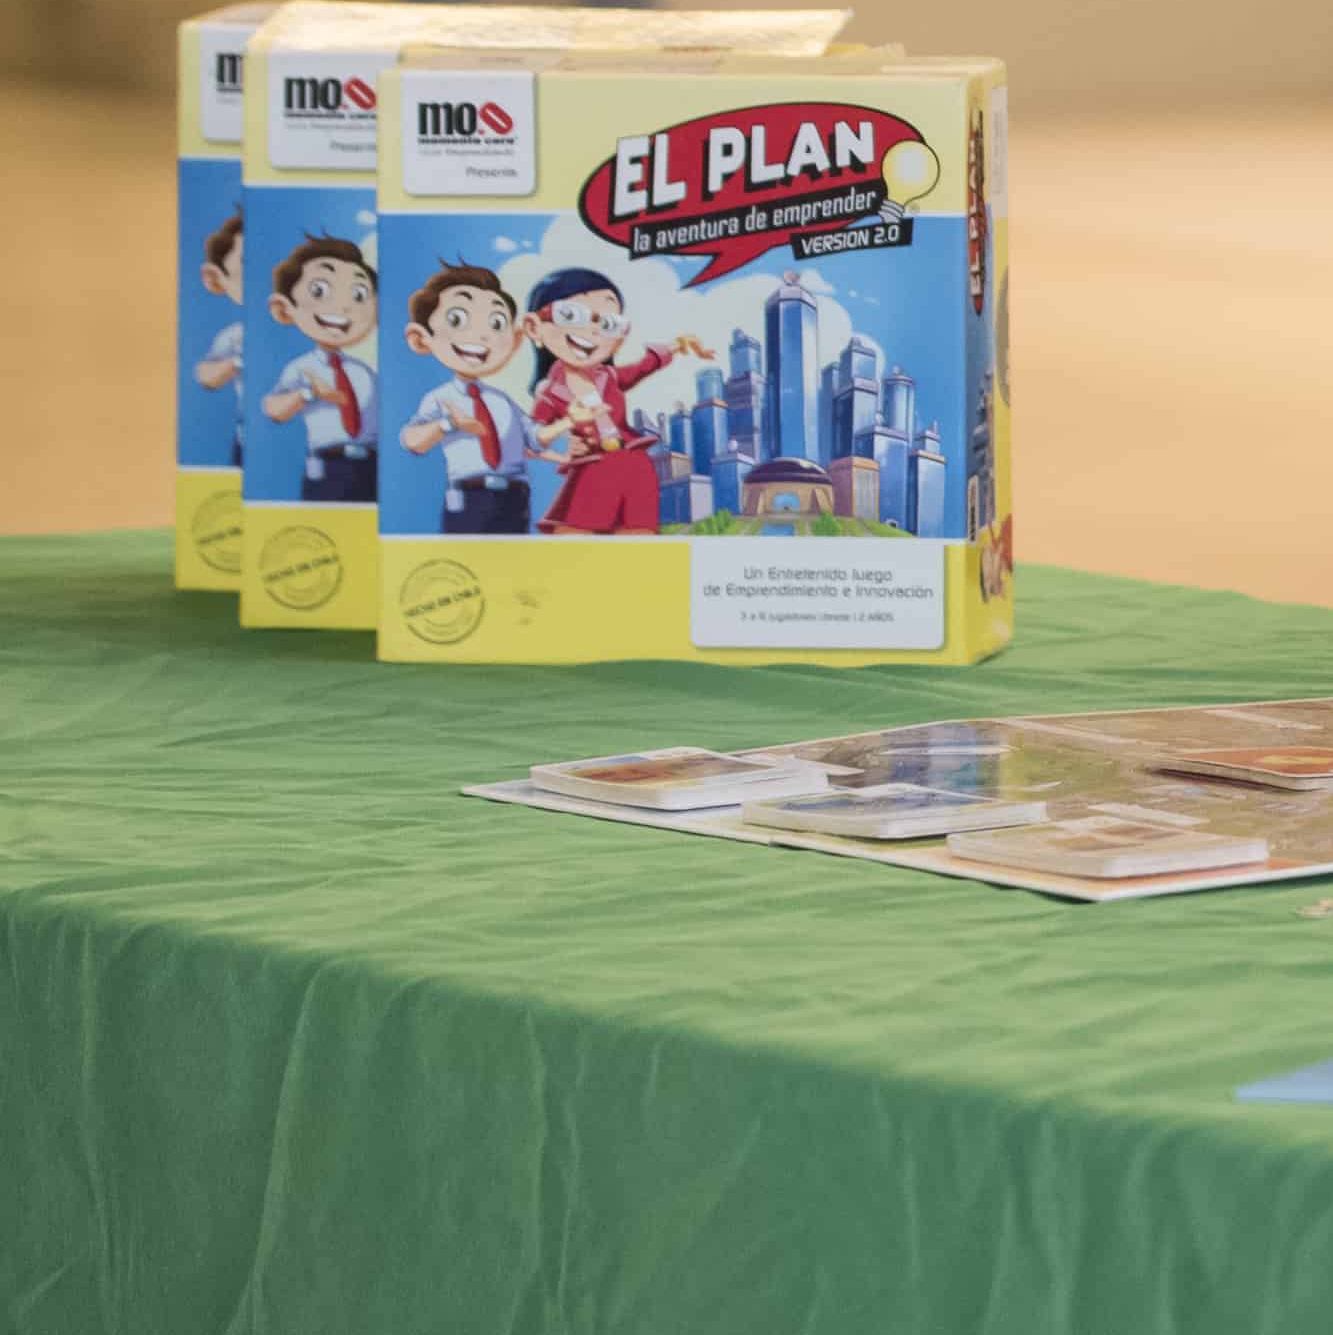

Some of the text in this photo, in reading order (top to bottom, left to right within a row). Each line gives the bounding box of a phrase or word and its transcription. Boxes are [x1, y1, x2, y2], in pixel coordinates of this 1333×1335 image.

[612, 120, 876, 216] EL PLAN
[632, 187, 877, 253] la aventura de emprender
[800, 223, 900, 255] VERSION 2.0
[703, 582, 720, 597] de
[726, 582, 838, 599] Emprendimiento
